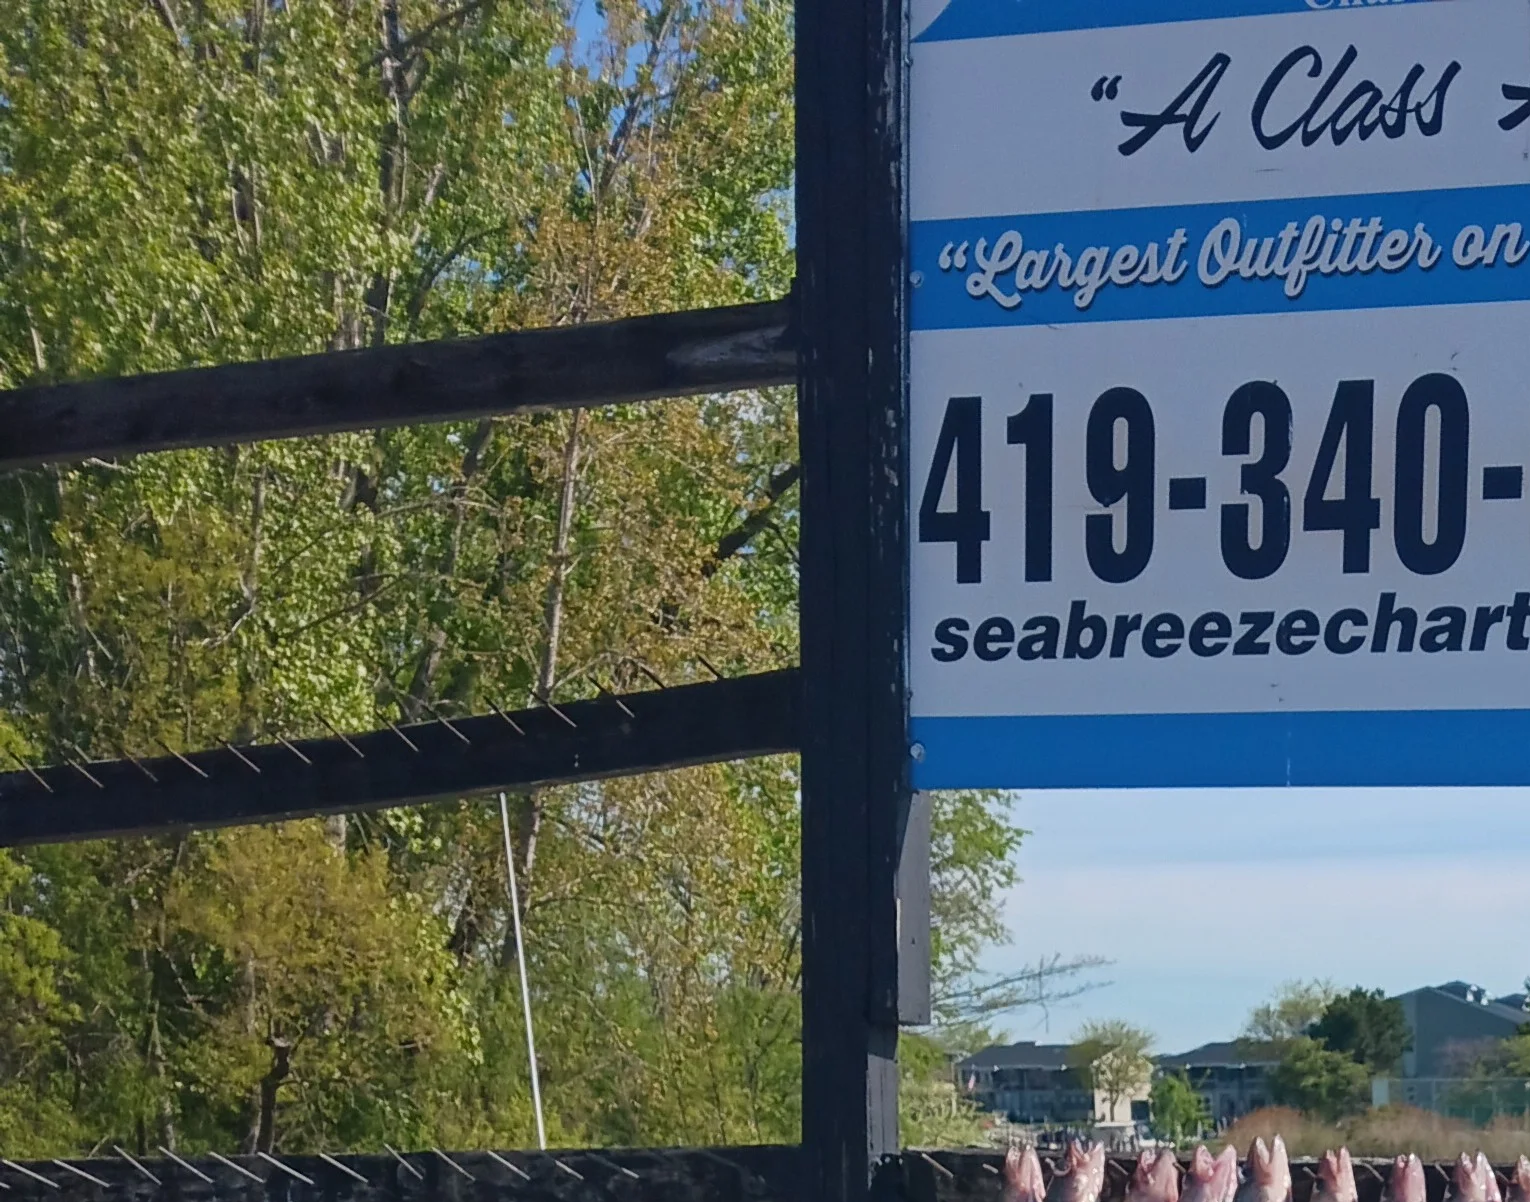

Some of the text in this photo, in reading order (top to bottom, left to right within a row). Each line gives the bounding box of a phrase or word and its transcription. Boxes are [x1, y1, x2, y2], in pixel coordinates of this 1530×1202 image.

[1251, 44, 1462, 150] Class
[938, 228, 1188, 309] “Largest
[1197, 214, 1444, 298] Outfitter
[1451, 221, 1530, 267] on
